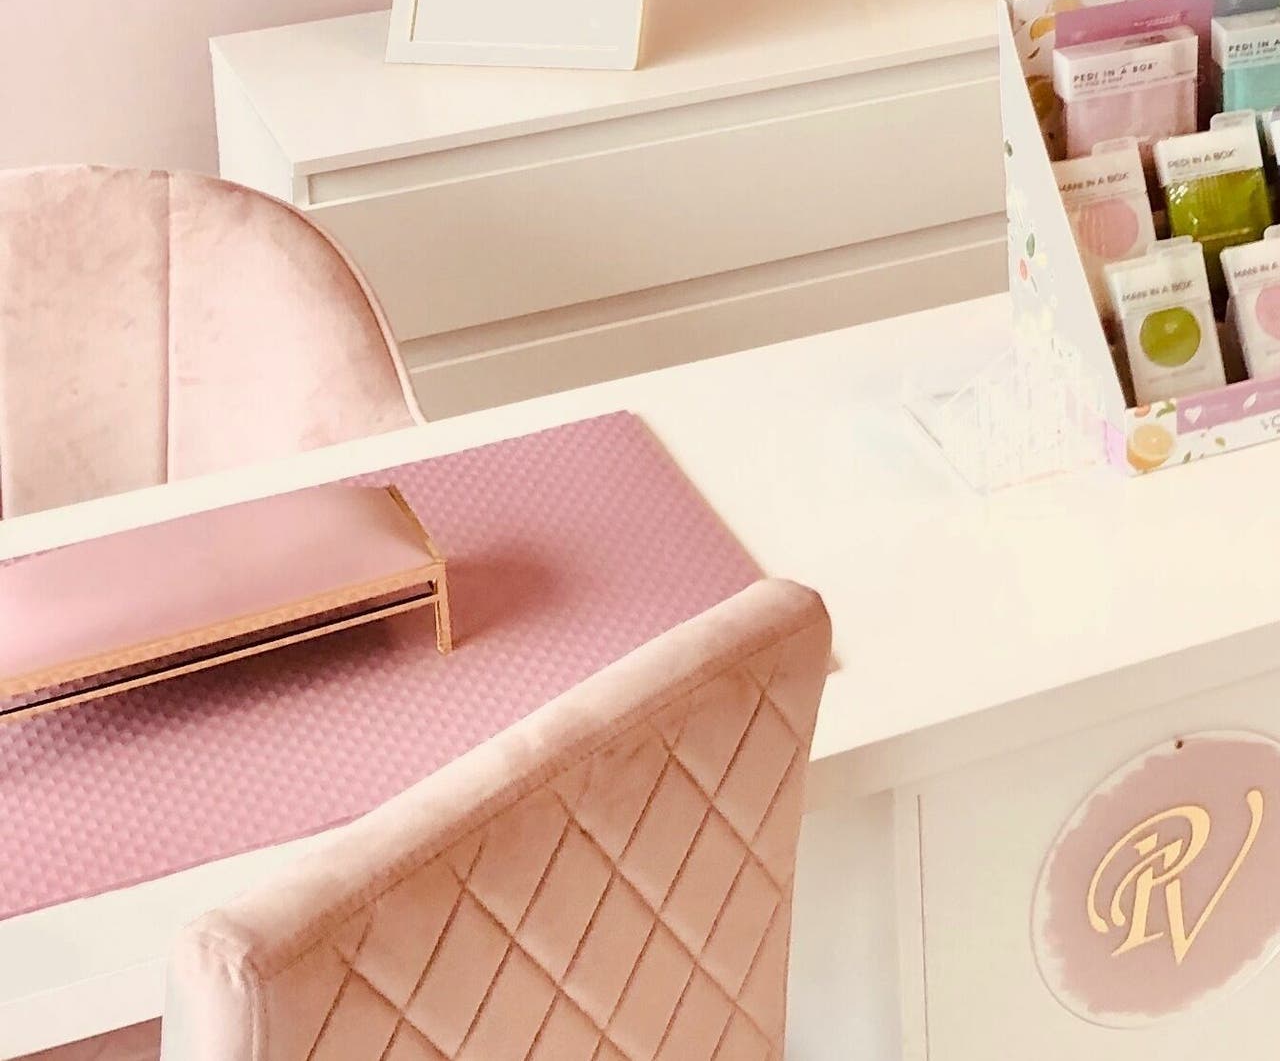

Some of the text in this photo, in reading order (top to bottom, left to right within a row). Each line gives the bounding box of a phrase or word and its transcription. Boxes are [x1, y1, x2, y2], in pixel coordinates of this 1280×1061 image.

[1228, 43, 1253, 52] PEDI
[1073, 71, 1099, 83] PEDI
[1103, 69, 1115, 77] IN
[1120, 67, 1127, 75] A
[1167, 158, 1190, 169] PEDI
[1204, 154, 1211, 162] A
